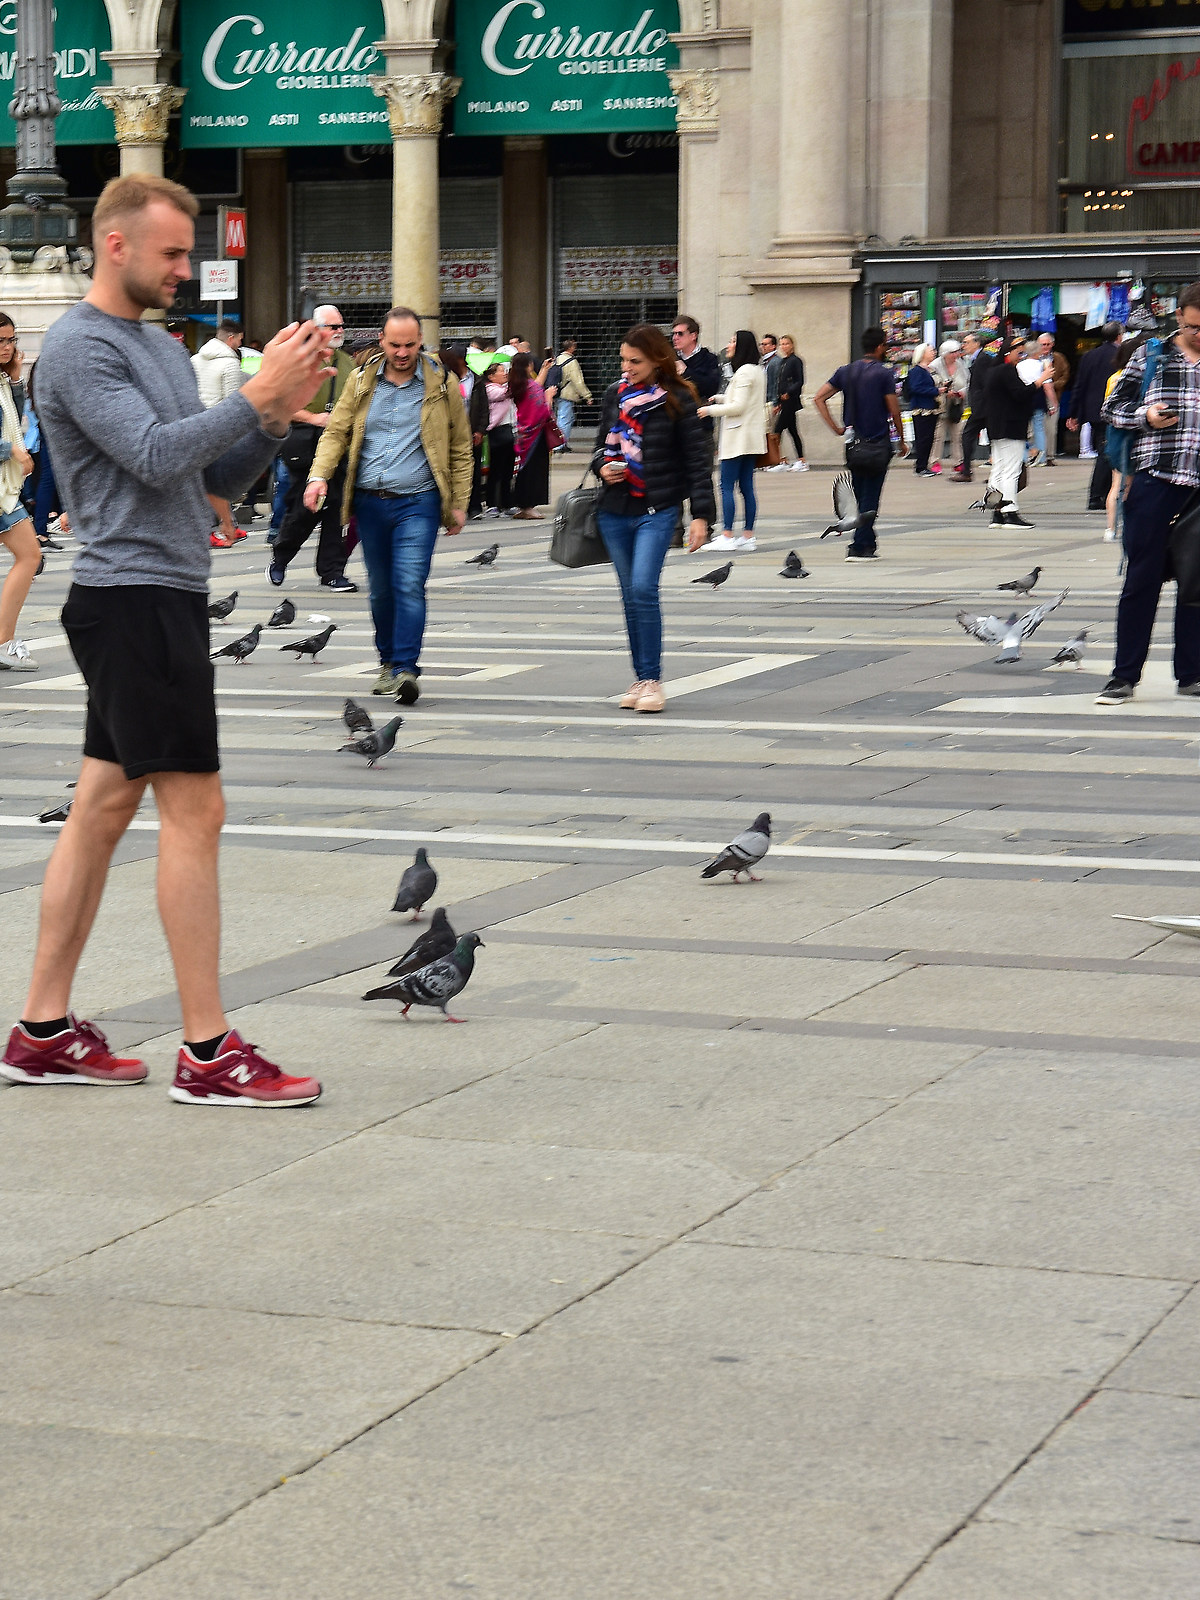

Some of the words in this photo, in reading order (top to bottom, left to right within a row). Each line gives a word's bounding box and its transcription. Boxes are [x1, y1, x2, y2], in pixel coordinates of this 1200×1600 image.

[480, 0, 668, 76] Currado
[202, 14, 379, 91] Currado
[558, 57, 666, 75] GIOIELLERIE
[467, 100, 530, 113] MILANO
[550, 99, 584, 112] ASTI
[602, 96, 680, 110] SANREMO
[190, 115, 249, 127] MILANO
[268, 113, 299, 126] ASTI
[318, 111, 390, 124] SANREMO
[226, 219, 246, 249] M
